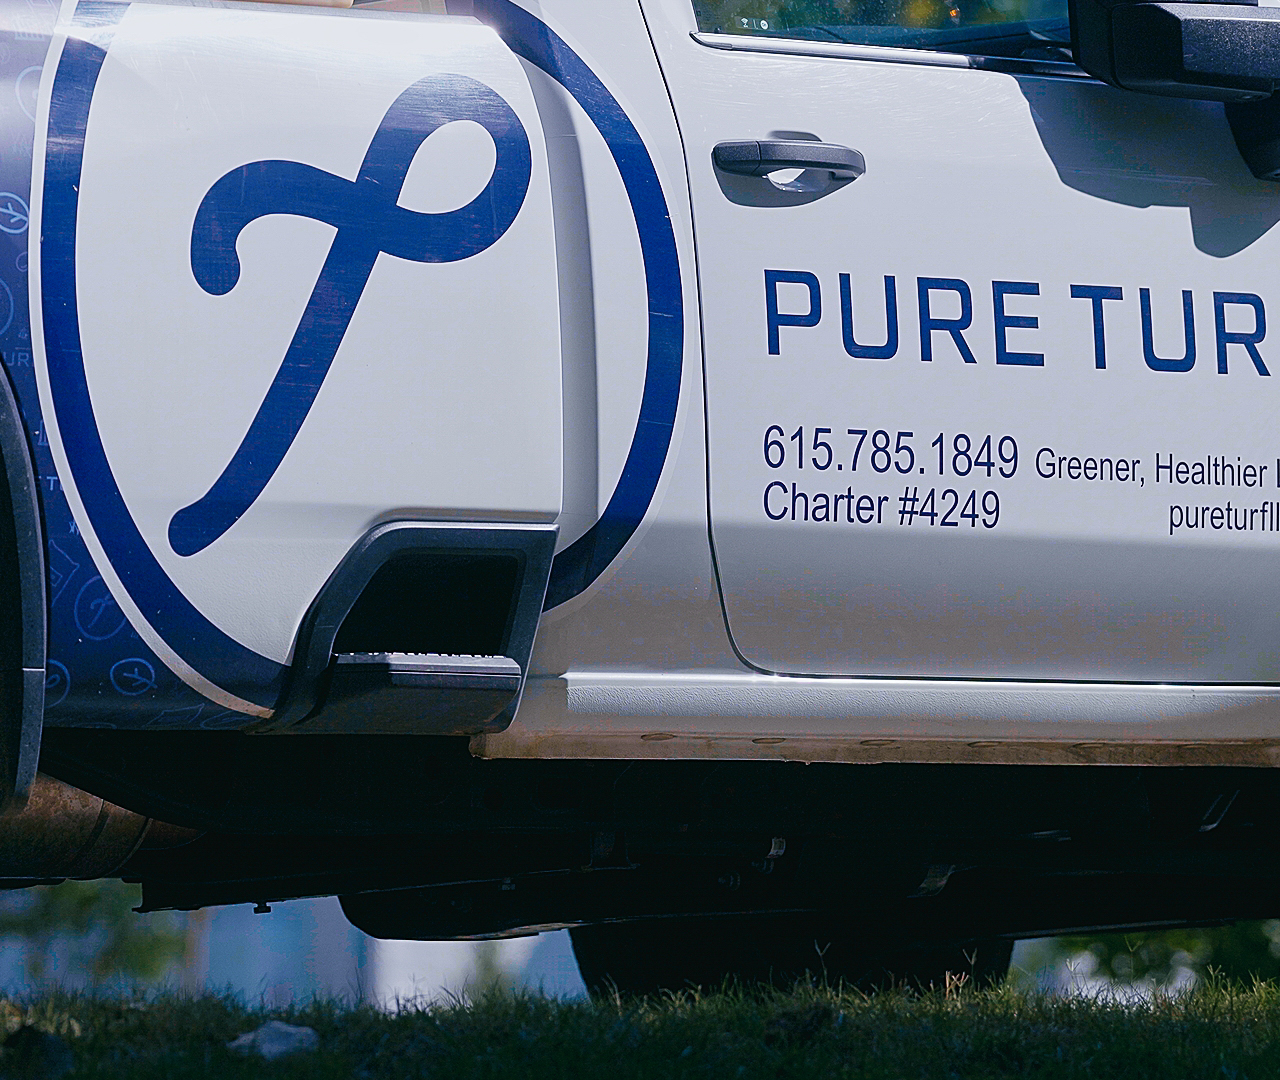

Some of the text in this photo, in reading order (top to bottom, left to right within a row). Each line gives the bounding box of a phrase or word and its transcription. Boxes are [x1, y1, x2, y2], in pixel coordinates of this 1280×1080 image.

[763, 269, 1046, 368] PURE
[763, 425, 1019, 479] 615.785.1849
[1035, 447, 1146, 489] Greener,
[1154, 453, 1268, 489] Healthier
[763, 481, 1001, 529] Charter #4249
